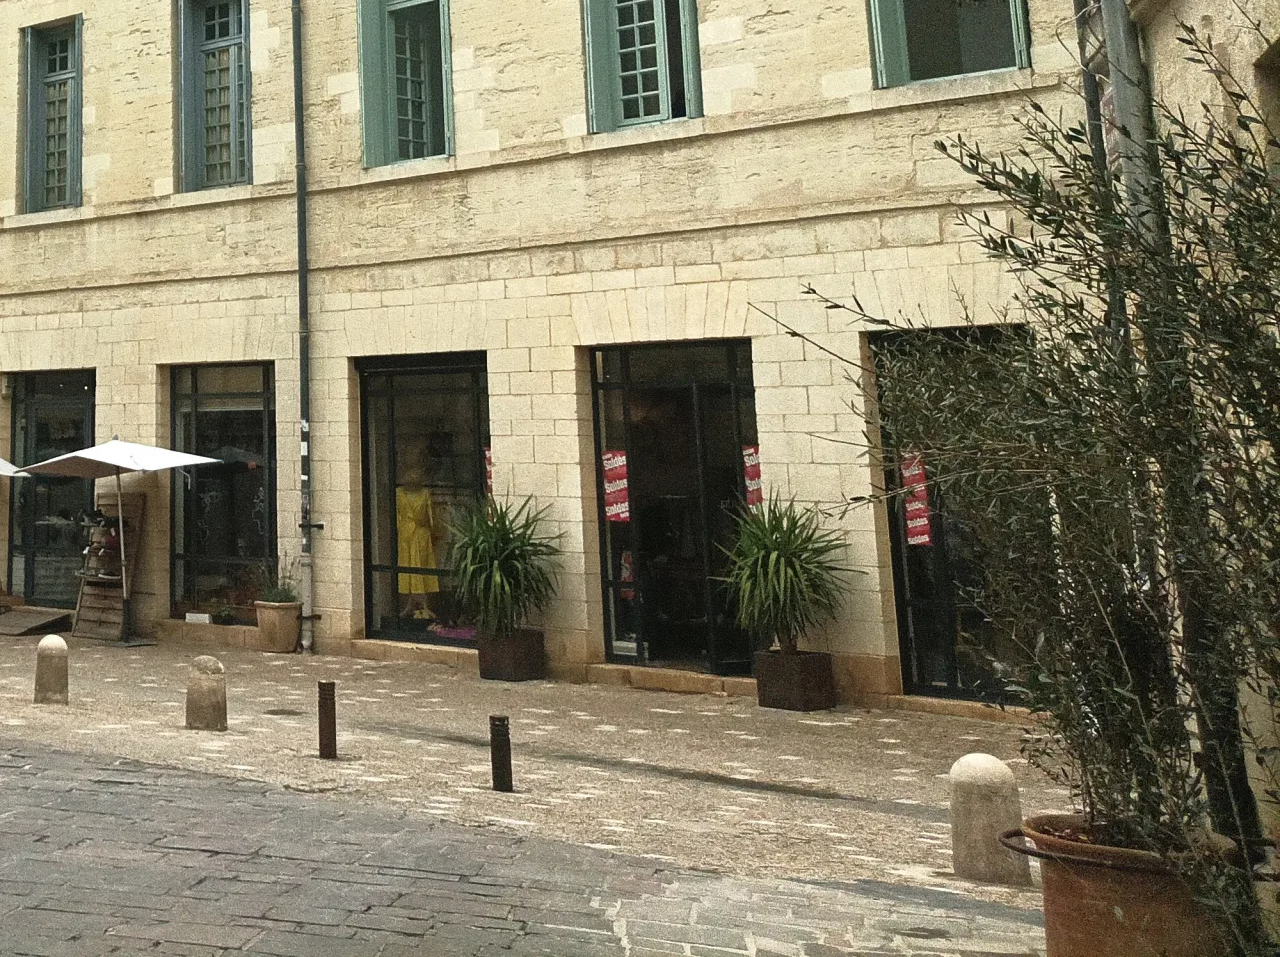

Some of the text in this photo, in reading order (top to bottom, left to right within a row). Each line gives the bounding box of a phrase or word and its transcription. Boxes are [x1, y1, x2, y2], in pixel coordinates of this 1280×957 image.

[603, 456, 627, 470] Soldes
[744, 453, 760, 466] Sol
[604, 479, 628, 493] Soldes
[605, 502, 629, 516] Soldes
